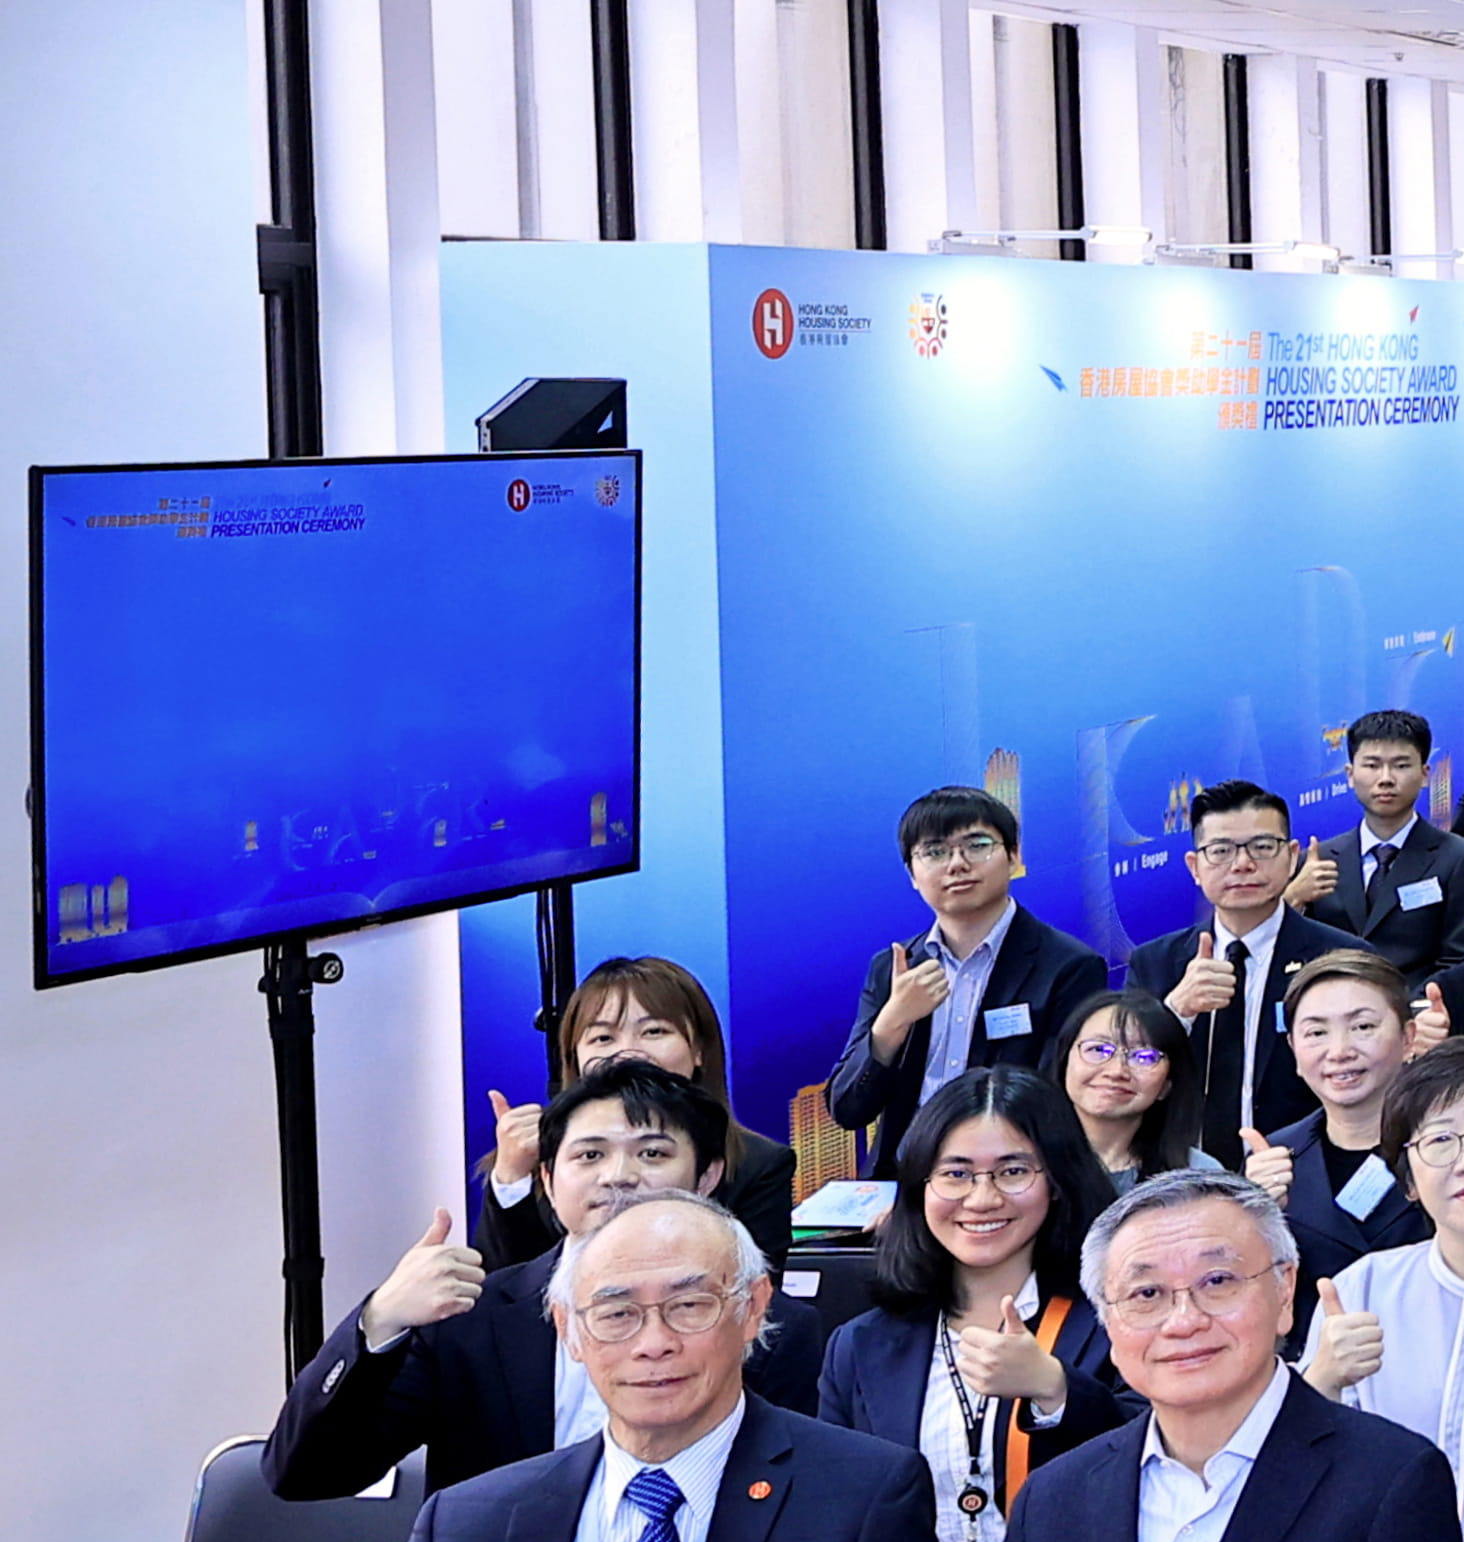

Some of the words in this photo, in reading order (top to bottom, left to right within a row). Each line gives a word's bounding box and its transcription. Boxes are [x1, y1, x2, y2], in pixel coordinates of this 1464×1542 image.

[798, 304, 823, 316] HONG
[824, 304, 848, 316] KONG
[798, 317, 836, 329] HOUSING
[838, 317, 872, 329] SOCIETY
[1267, 332, 1293, 361] The
[1295, 332, 1324, 361] 21st
[1328, 333, 1376, 362] HONG
[1379, 332, 1419, 361] KONG
[1266, 367, 1336, 397] HOUSING
[1341, 366, 1406, 395] SOCIETY
[1407, 364, 1457, 393] AWARD
[1264, 400, 1380, 430] PRESENTATION
[1383, 396, 1460, 426] CEREMONY
[213, 507, 268, 523] HOUSING
[270, 505, 322, 521] SOCIETY
[322, 503, 364, 518] AWARD
[211, 519, 300, 538] PRESENTATION
[300, 516, 366, 534] CEREMONY
[1141, 849, 1168, 870] Engage
